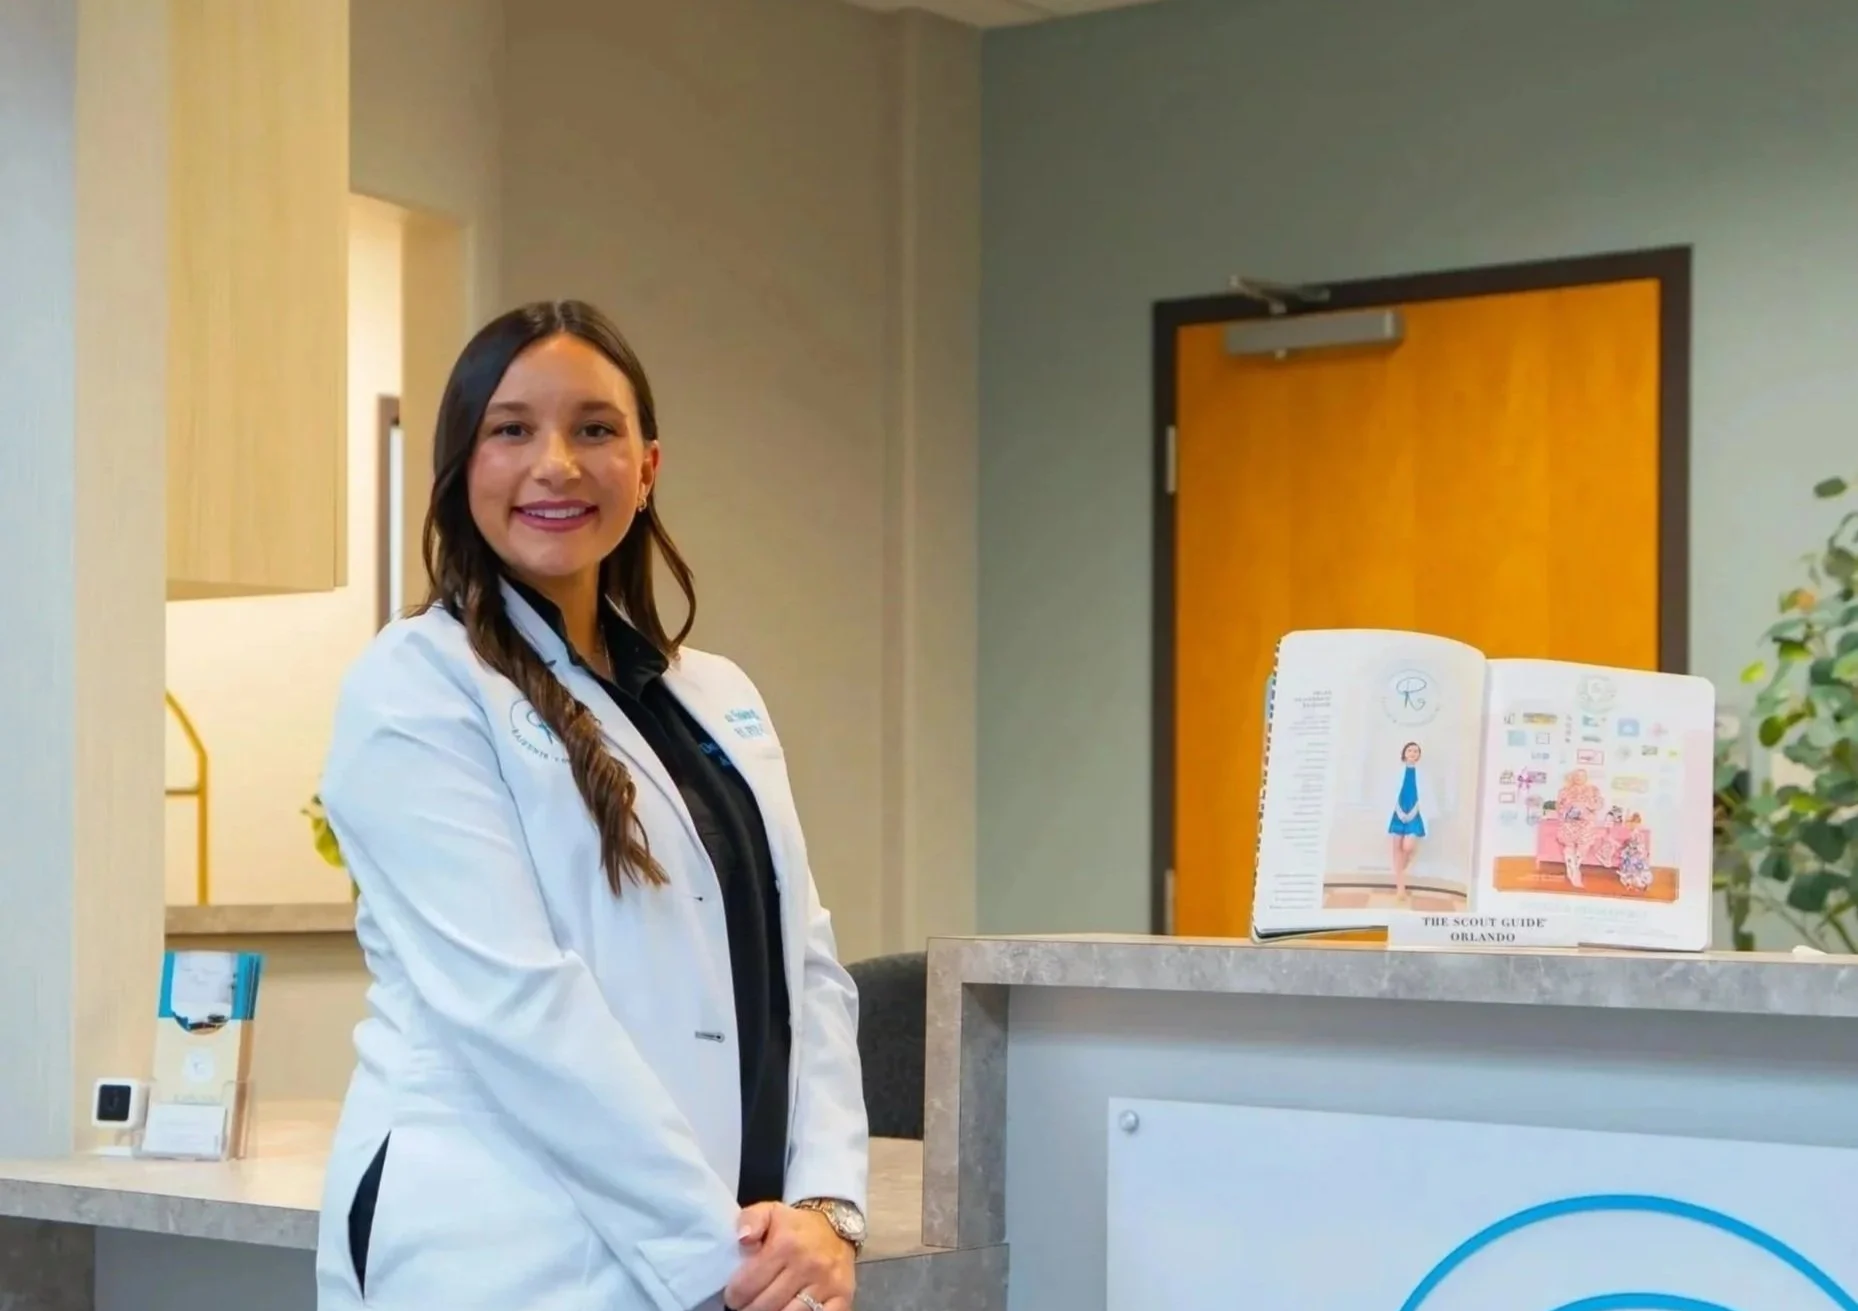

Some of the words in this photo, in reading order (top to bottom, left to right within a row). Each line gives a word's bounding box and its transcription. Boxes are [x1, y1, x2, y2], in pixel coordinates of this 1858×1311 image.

[1422, 916, 1449, 927] THE
[1453, 917, 1498, 927] SCOUT
[1450, 931, 1516, 942] ORLANDO
